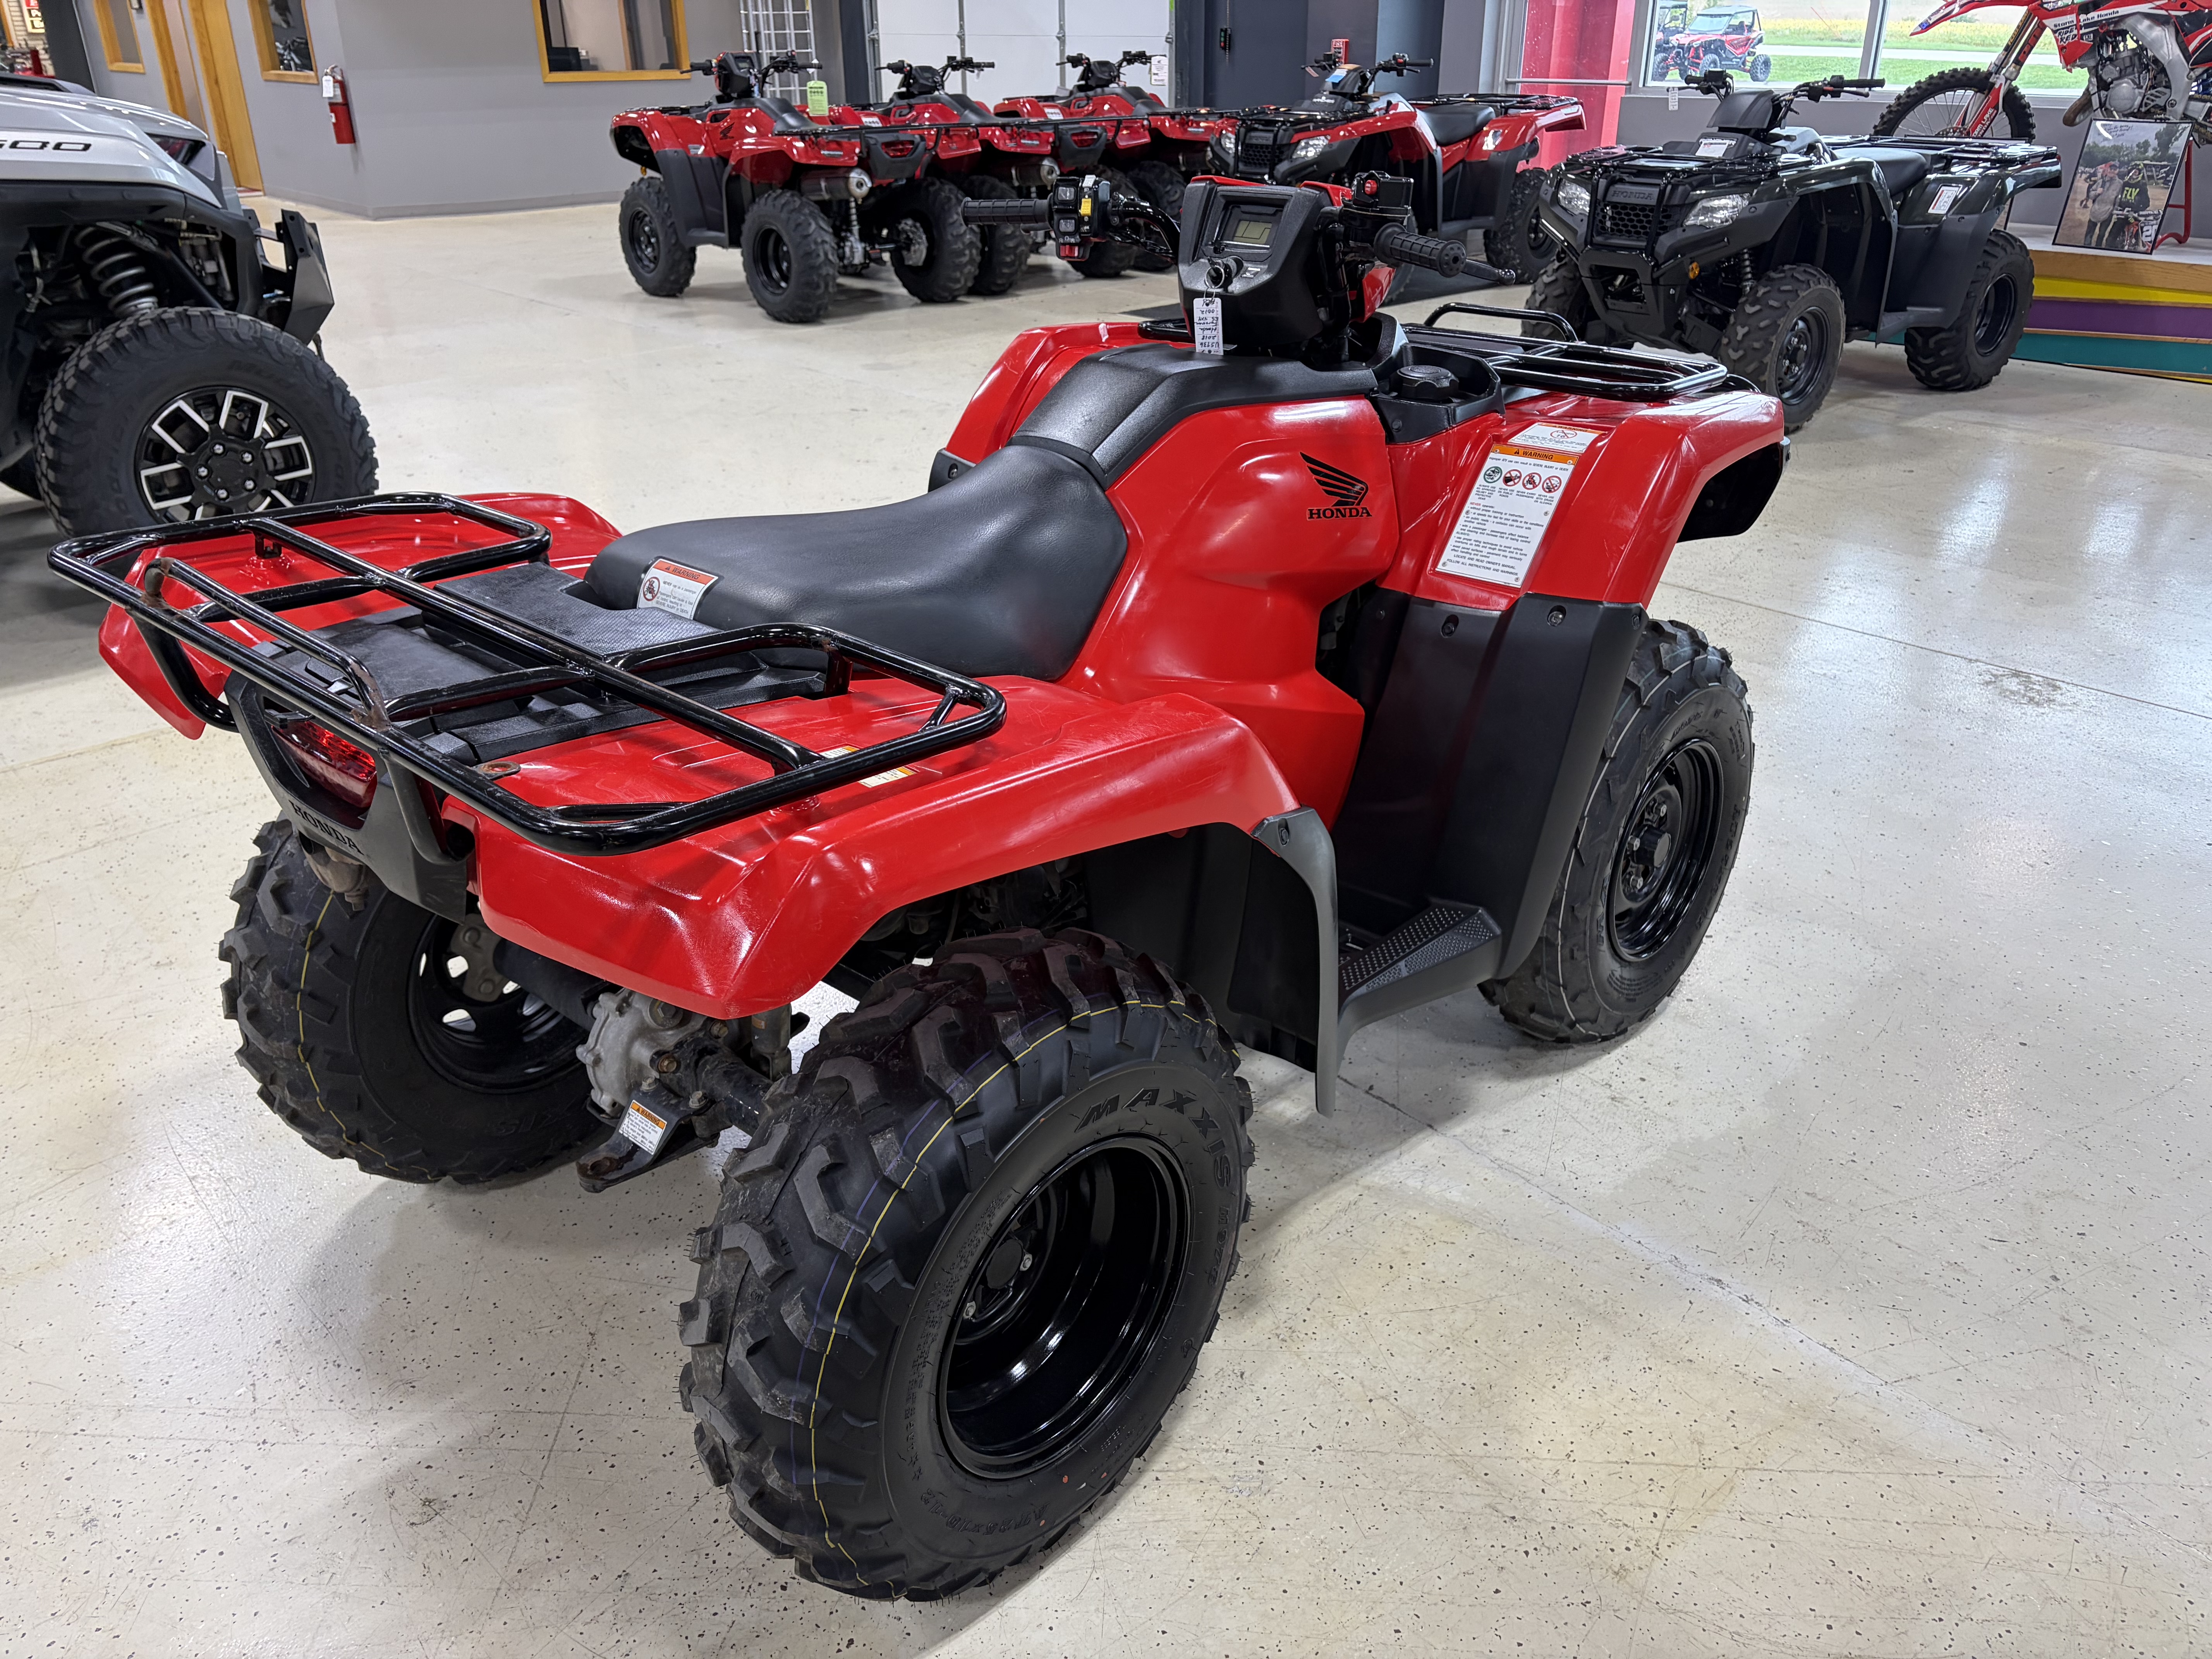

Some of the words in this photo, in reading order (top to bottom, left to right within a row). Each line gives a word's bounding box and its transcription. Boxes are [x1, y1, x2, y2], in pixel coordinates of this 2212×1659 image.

[2054, 20, 2074, 28] Storm
[2097, 10, 2119, 19] Honda
[2057, 27, 2075, 38] RIDE
[2059, 34, 2077, 44] RED
[1611, 190, 1653, 201] HONDA
[2122, 187, 2140, 200] FLY
[1521, 450, 1554, 460] WARNING
[1307, 507, 1372, 519] HONDA
[672, 567, 701, 580] WARNING
[289, 799, 364, 855] HONDA
[641, 1108, 660, 1125] WARNING
[1074, 1087, 1231, 1189] MAXXIS
